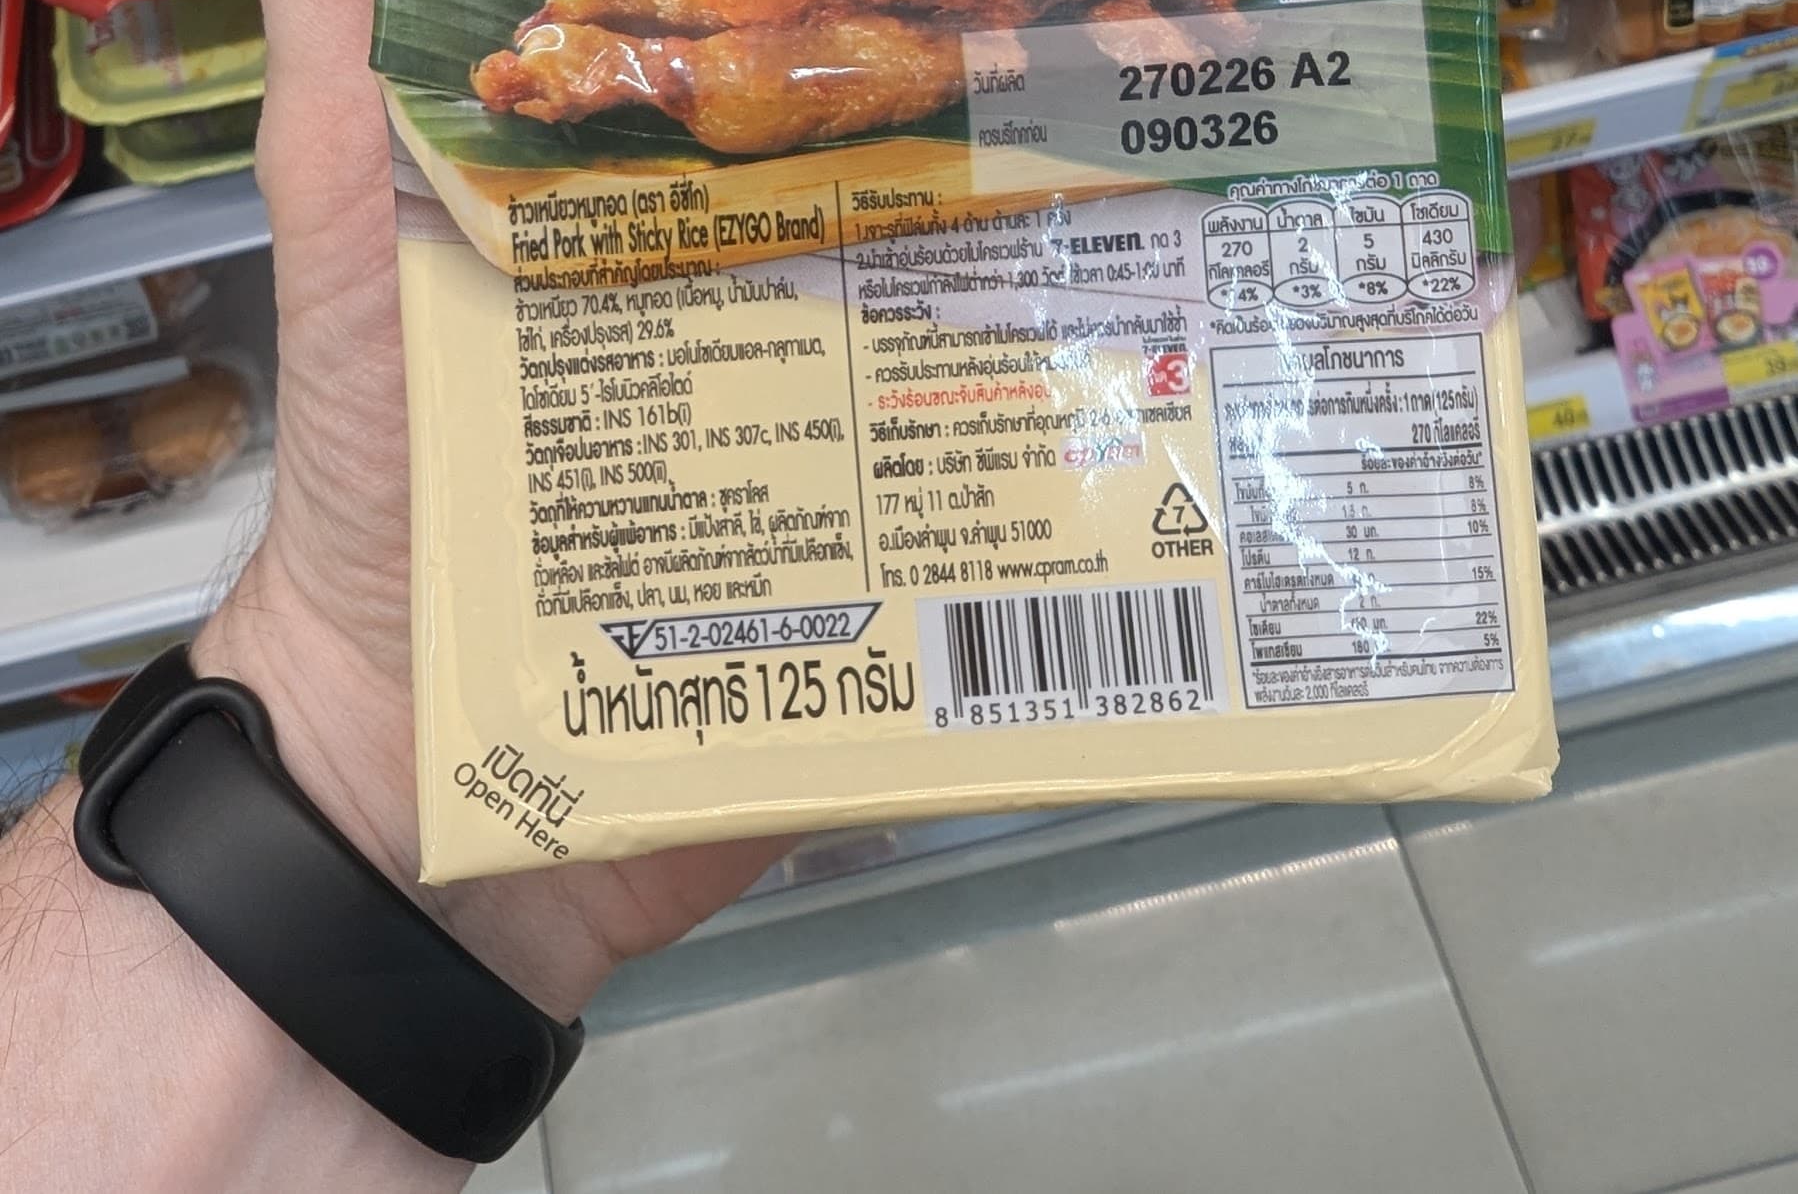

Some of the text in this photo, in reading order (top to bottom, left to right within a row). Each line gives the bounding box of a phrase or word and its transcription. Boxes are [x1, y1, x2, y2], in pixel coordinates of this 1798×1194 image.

[972, 61, 1025, 96] วันที่ผลิต
[1119, 51, 1351, 102] 270226 A2
[1121, 110, 1279, 155] 090326
[1409, 173, 1438, 188] ถาด
[508, 174, 710, 227] ข้าวเหนียวหมูทอด (ตรา อีซี่โก)
[852, 189, 934, 212] วิธีรับประทาน
[1348, 205, 1385, 224] ไขมัน
[1410, 202, 1460, 221] โซเดียม
[964, 213, 989, 233] ด้าน
[993, 210, 1030, 231] ด้านละ
[1208, 215, 1263, 234] พลังงาน
[1277, 206, 1324, 228] น้ำตาล
[513, 204, 825, 264] Fried Pork with Sticky Rice (EZYGO Brand)
[1151, 231, 1169, 249] กด
[1173, 230, 1182, 248] 3
[1298, 237, 1308, 253] 2
[1364, 233, 1375, 249] 5
[1423, 228, 1453, 246] 430
[1221, 242, 1253, 258] 270
[1356, 254, 1386, 272] กรัม
[1411, 249, 1467, 270] มิลลิกรัม
[514, 258, 713, 293] ส่วนประกอบที่สำคัญโดยประมาณ
[1163, 255, 1185, 279] นาที
[1289, 256, 1318, 275] กรัม
[516, 275, 798, 325] ข้าวเหนียว 70.4%, หมูทอด (เนื้อหมู, น้ำมันปาล์ม,
[861, 299, 932, 324] ข้อควรระวัง
[517, 318, 675, 352] ไข่ไก่, เครื่องปรุงรส) 29.6%
[520, 348, 655, 384] วัตถุปรุงแต่งรสอาหาร
[1167, 359, 1191, 392] 3
[521, 384, 577, 412] ไดโซเดียม
[524, 410, 591, 438] สีธรรมชาติ
[603, 409, 631, 430] INS
[870, 413, 941, 443] วิธีเก็บรักษา
[1412, 424, 1432, 444] 270
[526, 437, 633, 472] วัตถุเจือปนอาหาร
[672, 431, 702, 453] 301,
[706, 427, 731, 448] INS
[775, 421, 800, 443] INS
[873, 445, 1056, 479] ผลิตโดย บริษัท ซีพีแรม จำกัด
[528, 472, 553, 495] INS
[600, 464, 624, 486] INS
[1469, 476, 1484, 489] 8%
[719, 478, 769, 516] ซูคราโลส
[876, 483, 995, 521] 177 หมู่ 11 ต.ป่าสัก
[532, 520, 676, 560] ข้อมูลสำหรับผู้แพ้อาหาร
[768, 503, 851, 536] ผลิตภัณฑ์จาก
[879, 518, 1052, 556] อ.เมืองลำพูน จ.ลำพูน 51000
[1468, 518, 1489, 535] 10%
[1151, 538, 1214, 559] OTHER
[1241, 548, 1271, 567] โปรตีน
[534, 557, 584, 589] ถั่วเหลือง
[880, 550, 1109, 590] โทร. 0 2844 8118 www.cpram.co.th
[1472, 566, 1493, 581] 15%
[694, 580, 721, 604] หอย
[726, 573, 771, 601] และหมึก
[654, 611, 851, 652] 51-2-02461-6-0022
[1475, 610, 1498, 625] 22%
[1484, 633, 1500, 647] 5%
[562, 645, 916, 746] น้ำหนักสุทธิ 125 กรัม
[935, 689, 1201, 728] 8 851351 382862
[481, 743, 585, 830] เปิดที่นี่
[453, 761, 570, 861] Open Here
